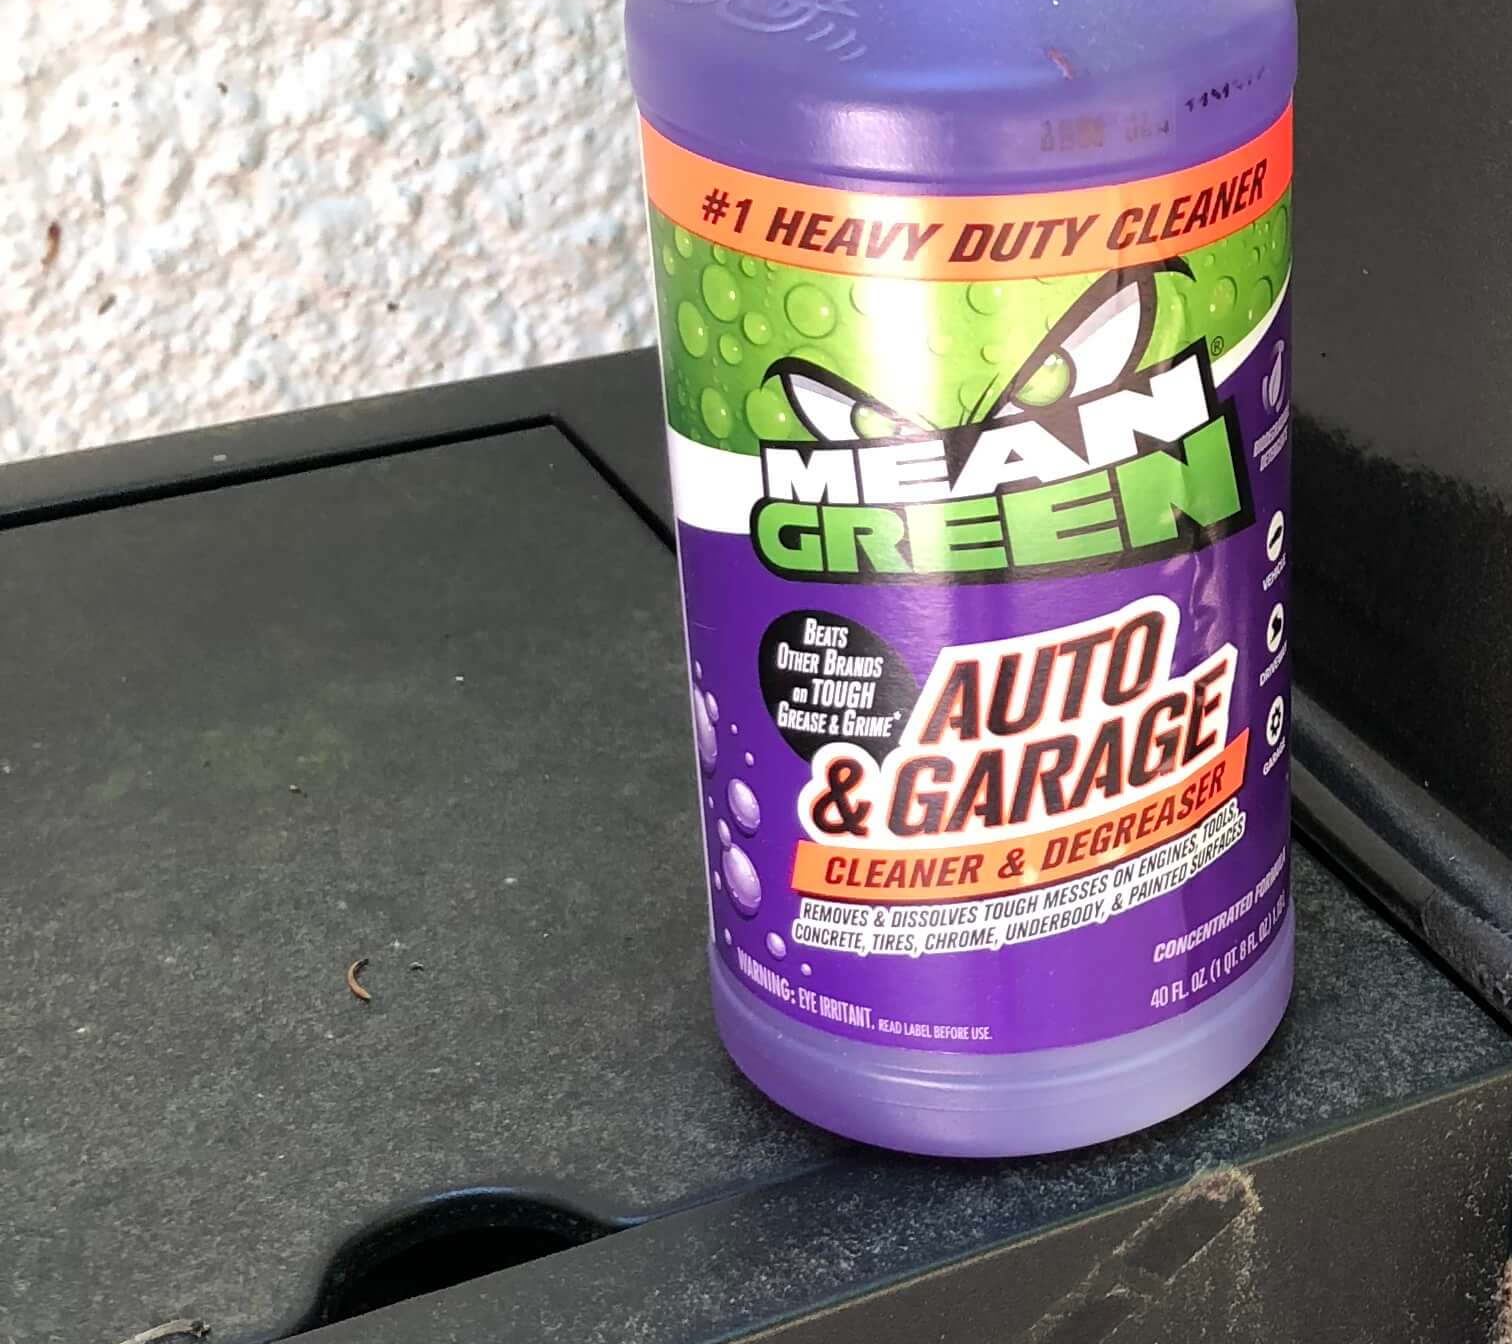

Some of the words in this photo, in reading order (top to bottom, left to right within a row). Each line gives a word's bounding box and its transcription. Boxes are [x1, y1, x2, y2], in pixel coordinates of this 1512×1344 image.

[701, 188, 753, 233] #1
[766, 207, 944, 261] HEAVY
[948, 214, 1100, 263] DUTY
[1107, 158, 1267, 250] CLEANER
[764, 354, 1210, 505] MEAN
[756, 415, 1241, 574] GREEN
[777, 642, 820, 674] OTHER
[823, 648, 883, 677] BRANDS
[803, 618, 848, 648] BEATS
[919, 610, 1166, 746] AUTO
[777, 701, 827, 733] GREASE
[828, 714, 839, 735] &
[792, 687, 808, 703] on
[812, 678, 876, 709] TOUGH
[811, 756, 871, 838] &
[886, 660, 1230, 836] GARAGE
[803, 902, 869, 927] REMOVES
[873, 910, 885, 927] &
[891, 906, 978, 928] DISSOLVES
[984, 897, 1038, 922] TOUGH
[1043, 874, 1108, 910] MESSES
[1114, 862, 1133, 888] ON
[1138, 830, 1199, 878] ENGINES,
[1202, 800, 1237, 843] TOOLS,
[824, 854, 985, 888] CLEANER
[997, 847, 1025, 879] &
[1042, 763, 1225, 871] DEGREASER
[795, 923, 866, 952] CONCRETE,
[872, 933, 918, 953] TIRES,
[925, 927, 998, 951] CHROME,
[1006, 899, 1105, 941] UNDERBODY,
[1112, 893, 1123, 911] &
[1128, 862, 1188, 906] PAINTED
[1190, 817, 1243, 875] SURFACES
[1153, 891, 1253, 963] CONCENTRATED
[738, 947, 796, 1004] WARNING:
[798, 987, 817, 1014] EYE
[819, 995, 876, 1030] IRRITANT.
[1151, 986, 1168, 1009] 40
[1172, 980, 1189, 1002] FL.
[1210, 958, 1222, 983] (1
[1240, 939, 1247, 961] 8
[878, 1019, 902, 1035] READ
[903, 1022, 932, 1038] LABEL
[934, 1024, 969, 1040] BEFORE
